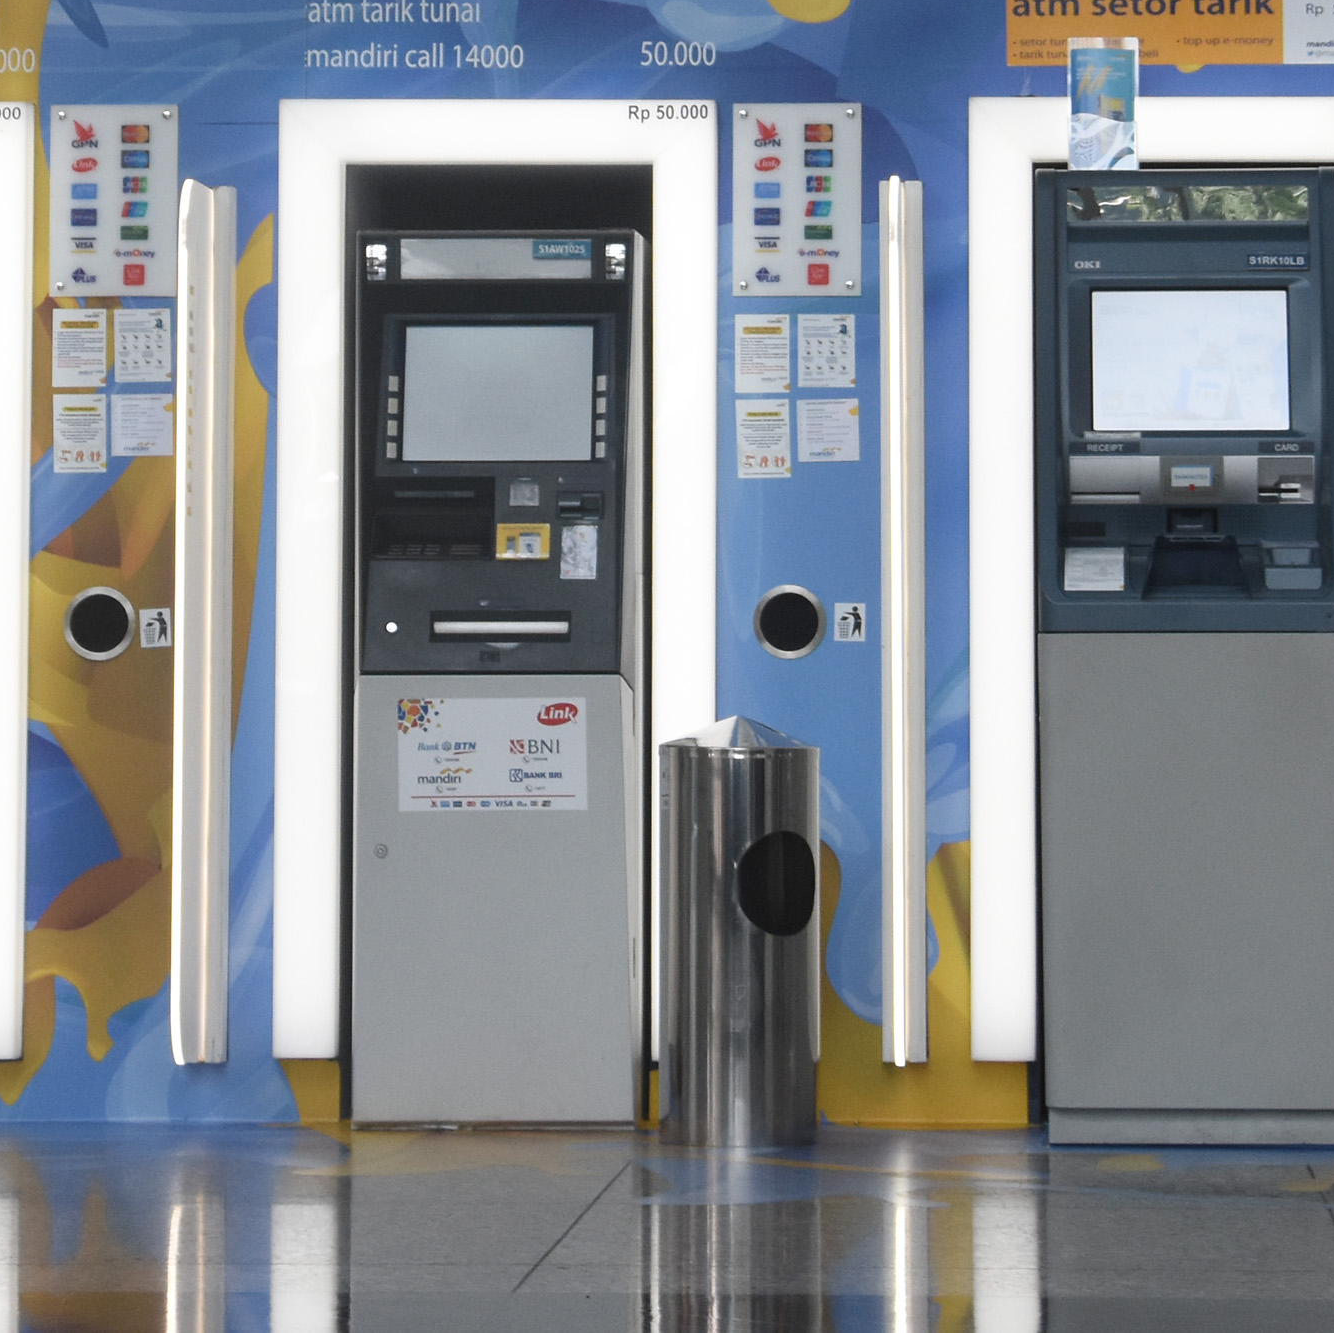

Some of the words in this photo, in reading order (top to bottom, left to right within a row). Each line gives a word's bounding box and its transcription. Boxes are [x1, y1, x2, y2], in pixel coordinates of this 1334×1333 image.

[1305, 3, 1324, 16] Rp
[1183, 36, 1203, 48] top
[1205, 38, 1220, 48] up
[306, 42, 398, 68] mandiri
[405, 42, 444, 68] call
[453, 44, 524, 69] 14000
[640, 41, 716, 66] 50.000
[628, 105, 651, 124] Rp
[656, 104, 709, 120] 50.000
[71, 139, 99, 149] GPN
[753, 138, 782, 148] GPN
[74, 241, 95, 249] VISA
[538, 244, 585, 254] S1AW1025
[758, 240, 778, 249] VISA
[1074, 260, 1101, 269] OKI
[1249, 254, 1305, 266] S1RK10LB
[1086, 443, 1124, 452] RECEIPT
[1274, 443, 1299, 452] CARD
[540, 704, 578, 725] Link
[417, 741, 441, 752] Bank
[453, 741, 477, 751] BTN
[527, 738, 561, 754] BNI
[417, 773, 462, 785] mandiri
[523, 771, 547, 779] BANK
[548, 771, 563, 779] BRI
[494, 800, 514, 808] VISA
